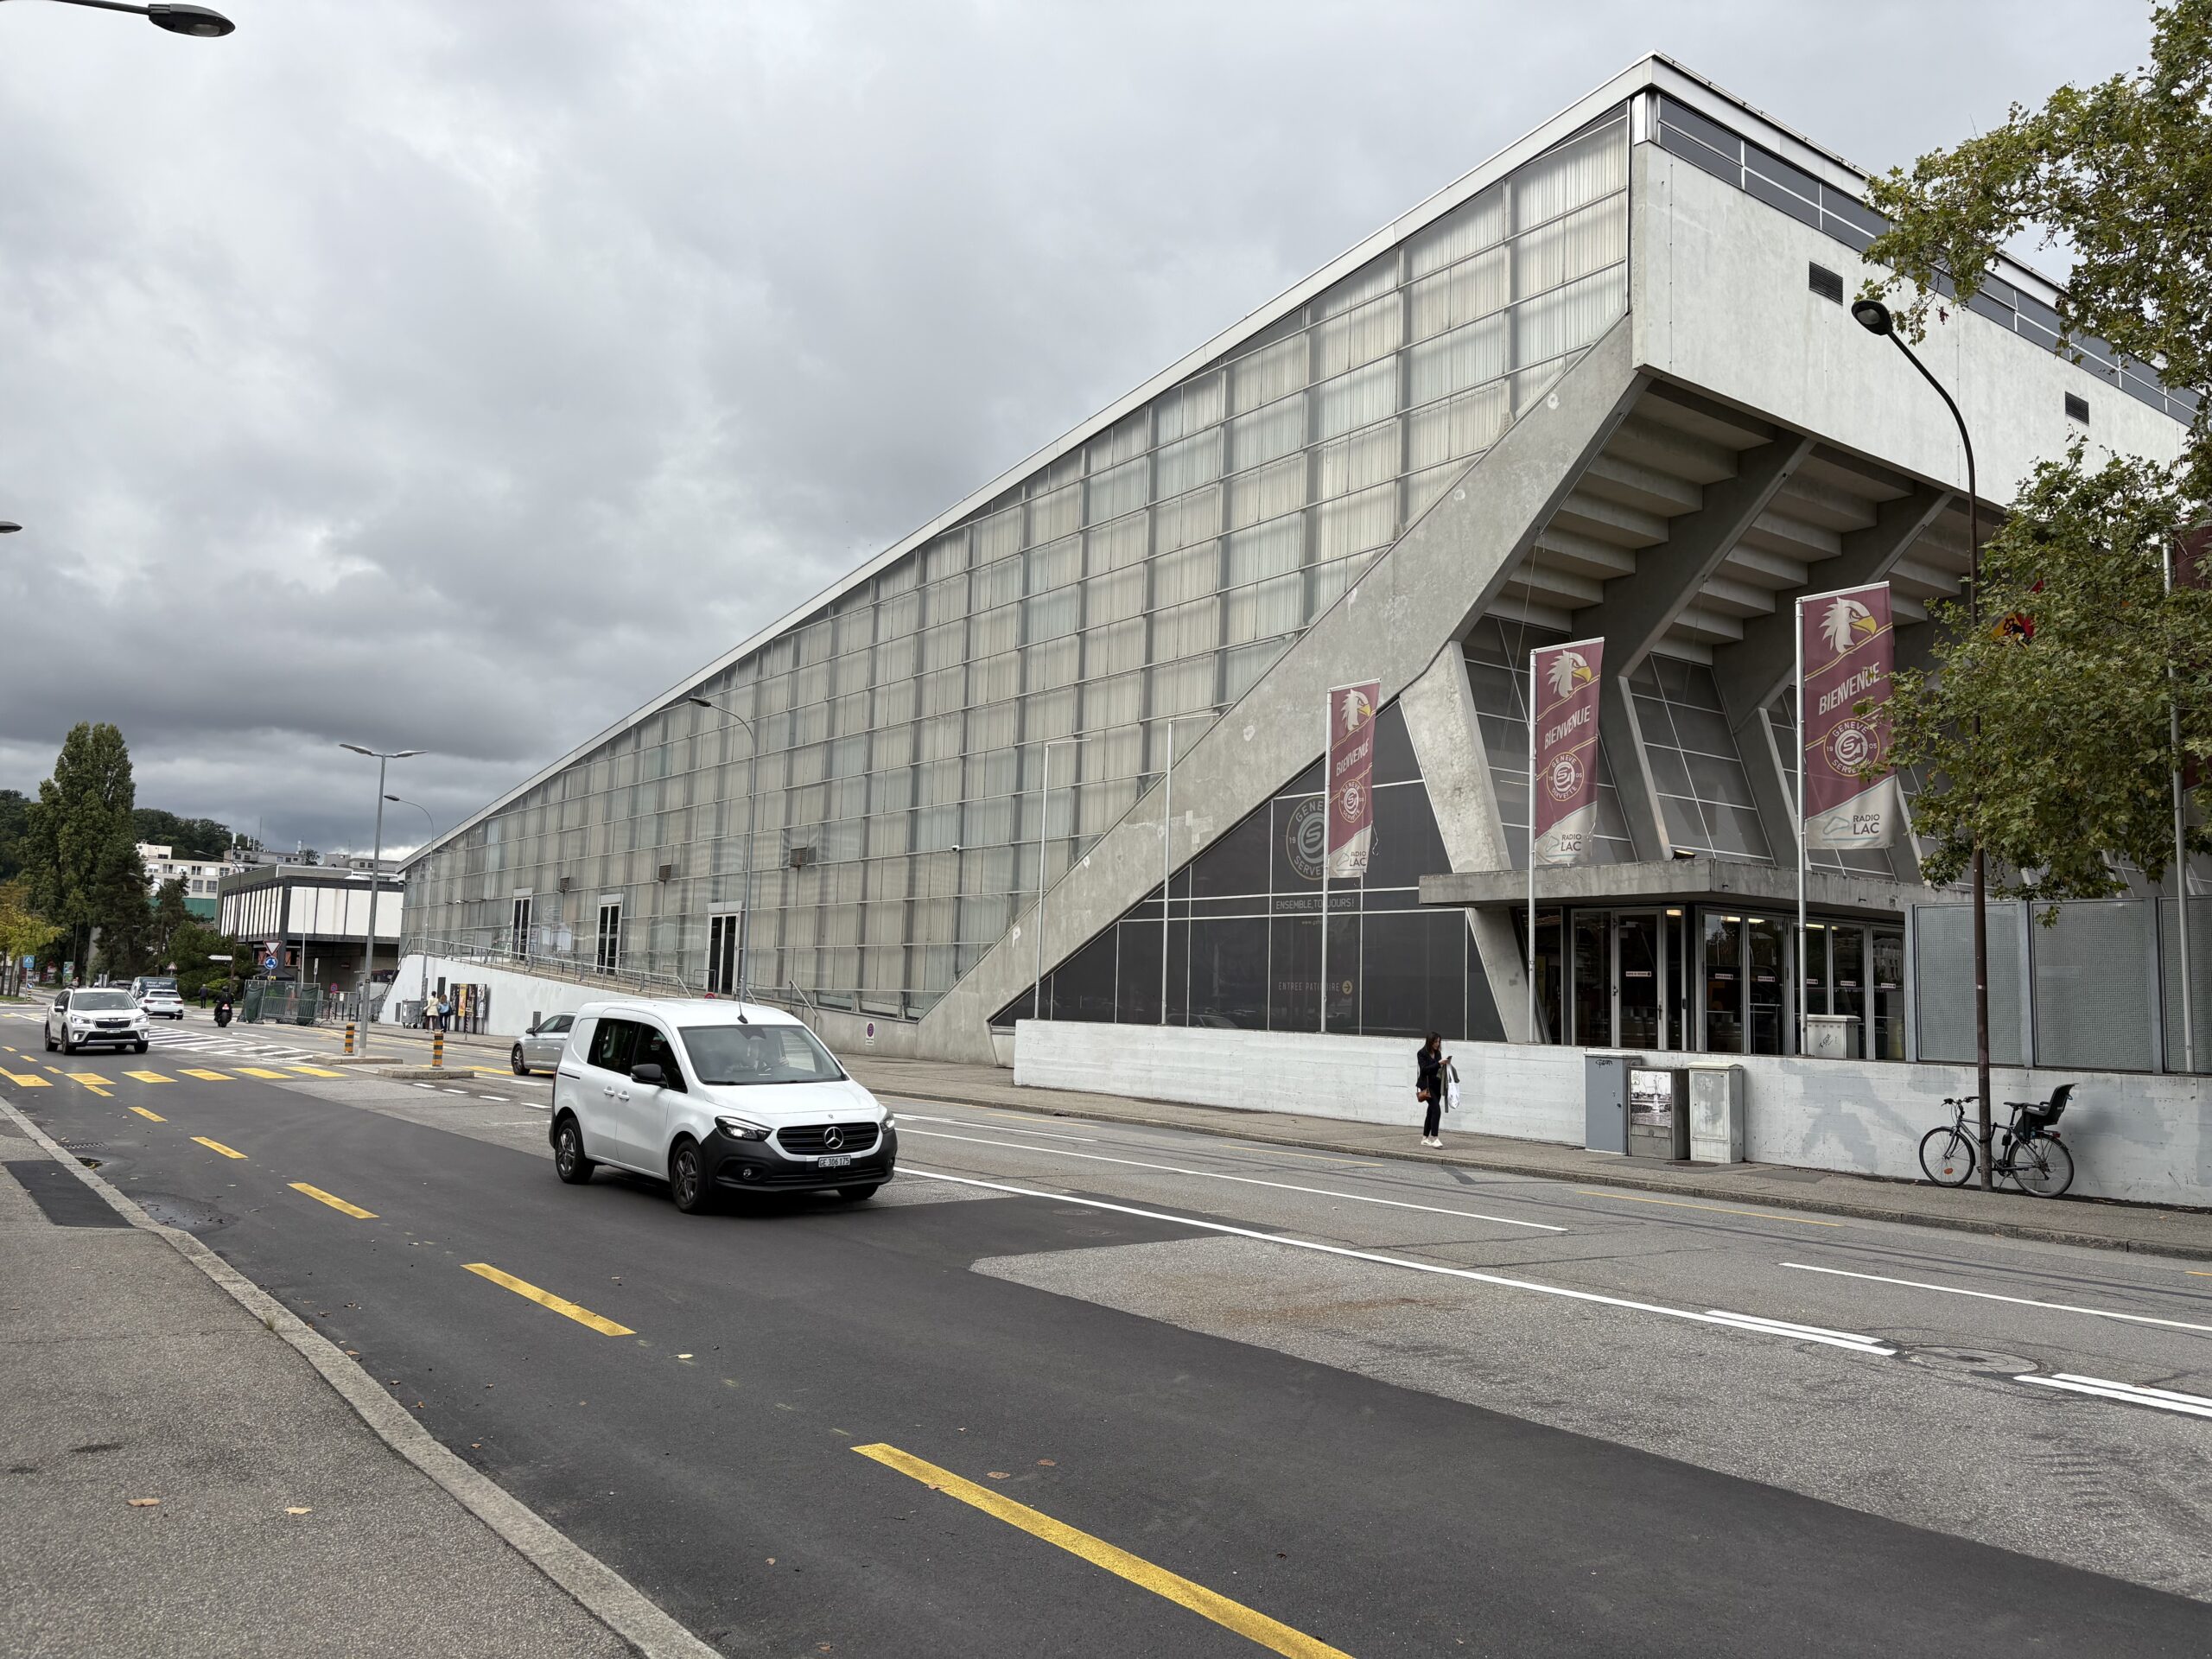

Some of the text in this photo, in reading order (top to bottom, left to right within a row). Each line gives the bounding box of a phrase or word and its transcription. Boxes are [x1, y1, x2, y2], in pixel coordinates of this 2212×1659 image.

[1818, 661, 1880, 715] BIENVENUE
[1544, 704, 1592, 750] BIENVENUE
[1832, 721, 1867, 737] GENEVE
[1853, 814, 1880, 823] RADIO
[1853, 822, 1880, 836] LAC
[1560, 841, 1581, 852] LAC
[1349, 857, 1367, 867] LAC
